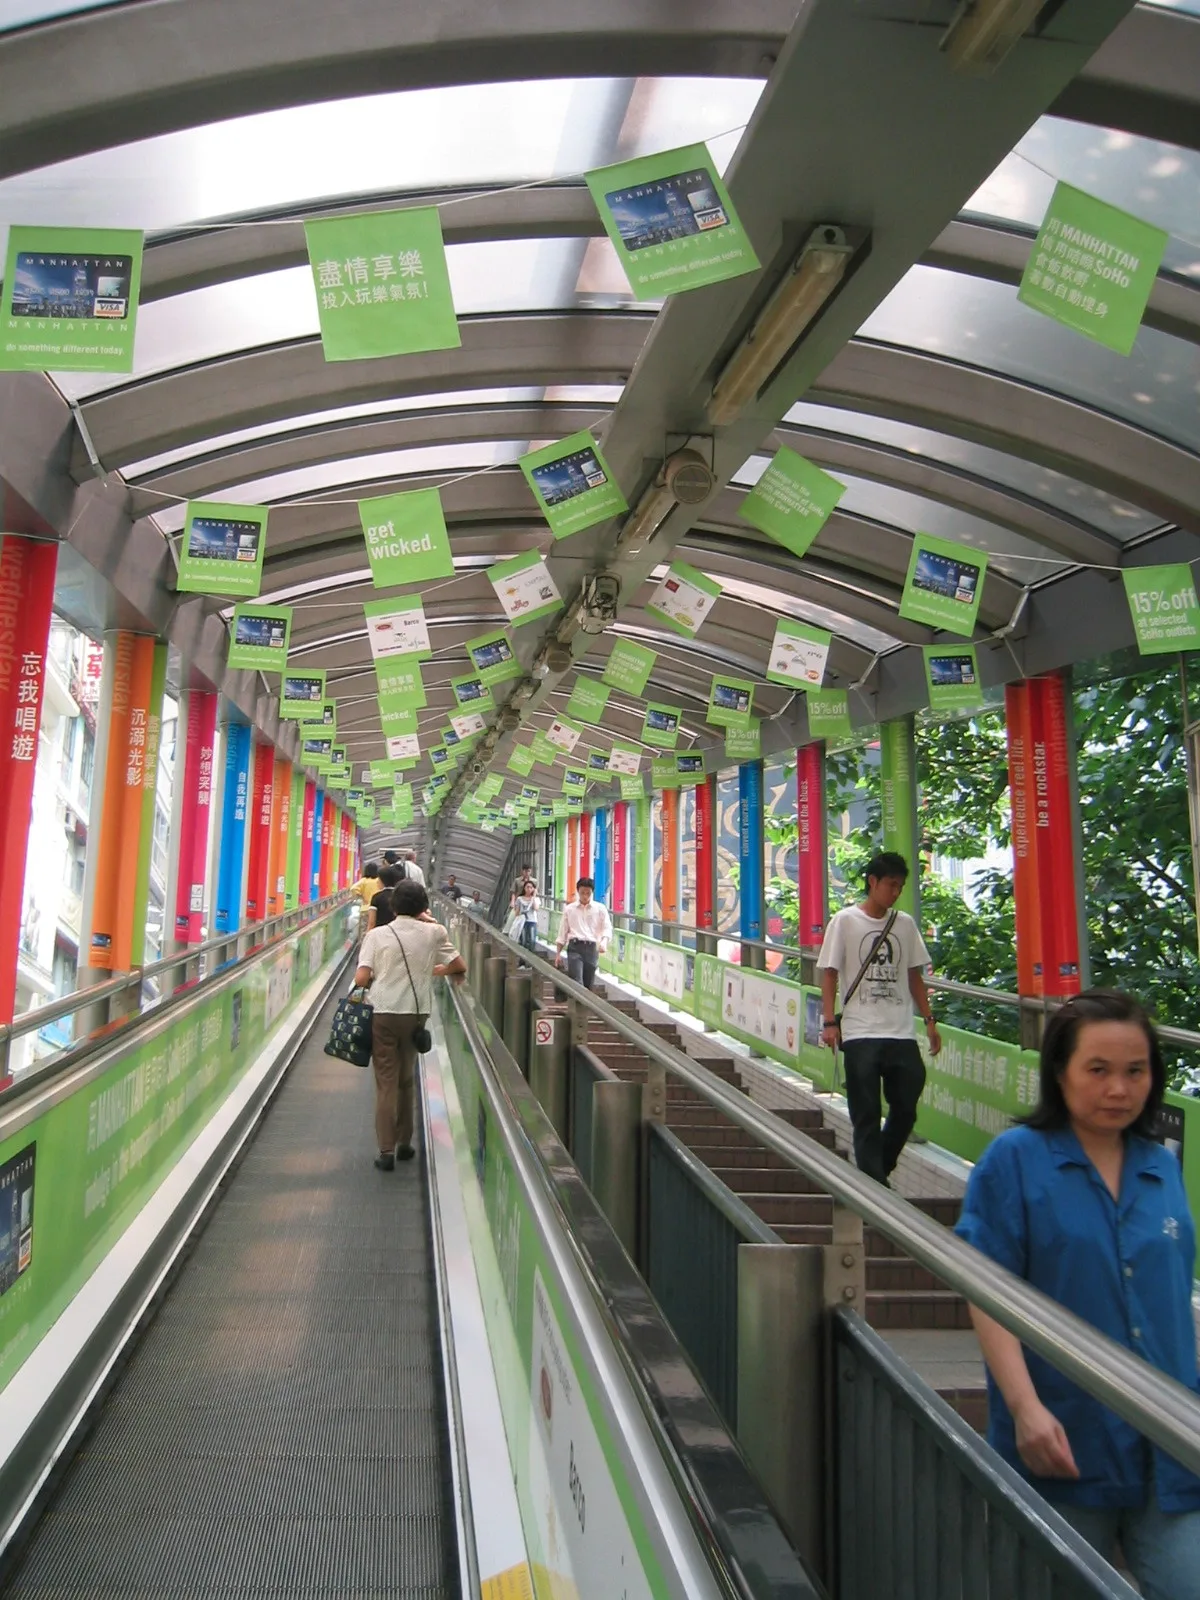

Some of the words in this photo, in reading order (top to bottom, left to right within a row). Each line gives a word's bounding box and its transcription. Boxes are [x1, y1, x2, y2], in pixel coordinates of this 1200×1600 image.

[615, 175, 702, 203] MANHATTAN
[629, 227, 736, 263] MANHATTAN
[26, 258, 123, 268] MANHATTAN
[317, 250, 424, 289] 盡情享樂
[99, 303, 120, 311] VISA
[8, 321, 128, 332] MANHATTAN
[6, 344, 17, 352] do
[18, 343, 61, 354] something
[62, 345, 98, 353] different
[197, 521, 256, 530] MANHATTAN
[367, 521, 396, 543] get
[371, 533, 437, 560] wicked.
[1131, 591, 1170, 613] 15%
[1171, 588, 1196, 610] off
[1149, 613, 1188, 627] selected
[11, 652, 42, 761] 忘我唱遊
[809, 702, 832, 715] 15%
[832, 702, 847, 714] off
[728, 729, 745, 739] 15%
[746, 729, 760, 740] off
[126, 708, 146, 786] 沉溺光影
[1033, 741, 1048, 796] rockstar.
[799, 778, 808, 802] blues.
[800, 804, 809, 817] the
[1039, 800, 1048, 808] a
[800, 819, 809, 833] out
[1014, 789, 1029, 857] experience
[1036, 811, 1049, 827] be
[800, 834, 810, 852] kick
[0, 1156, 33, 1190] NHATTAN
